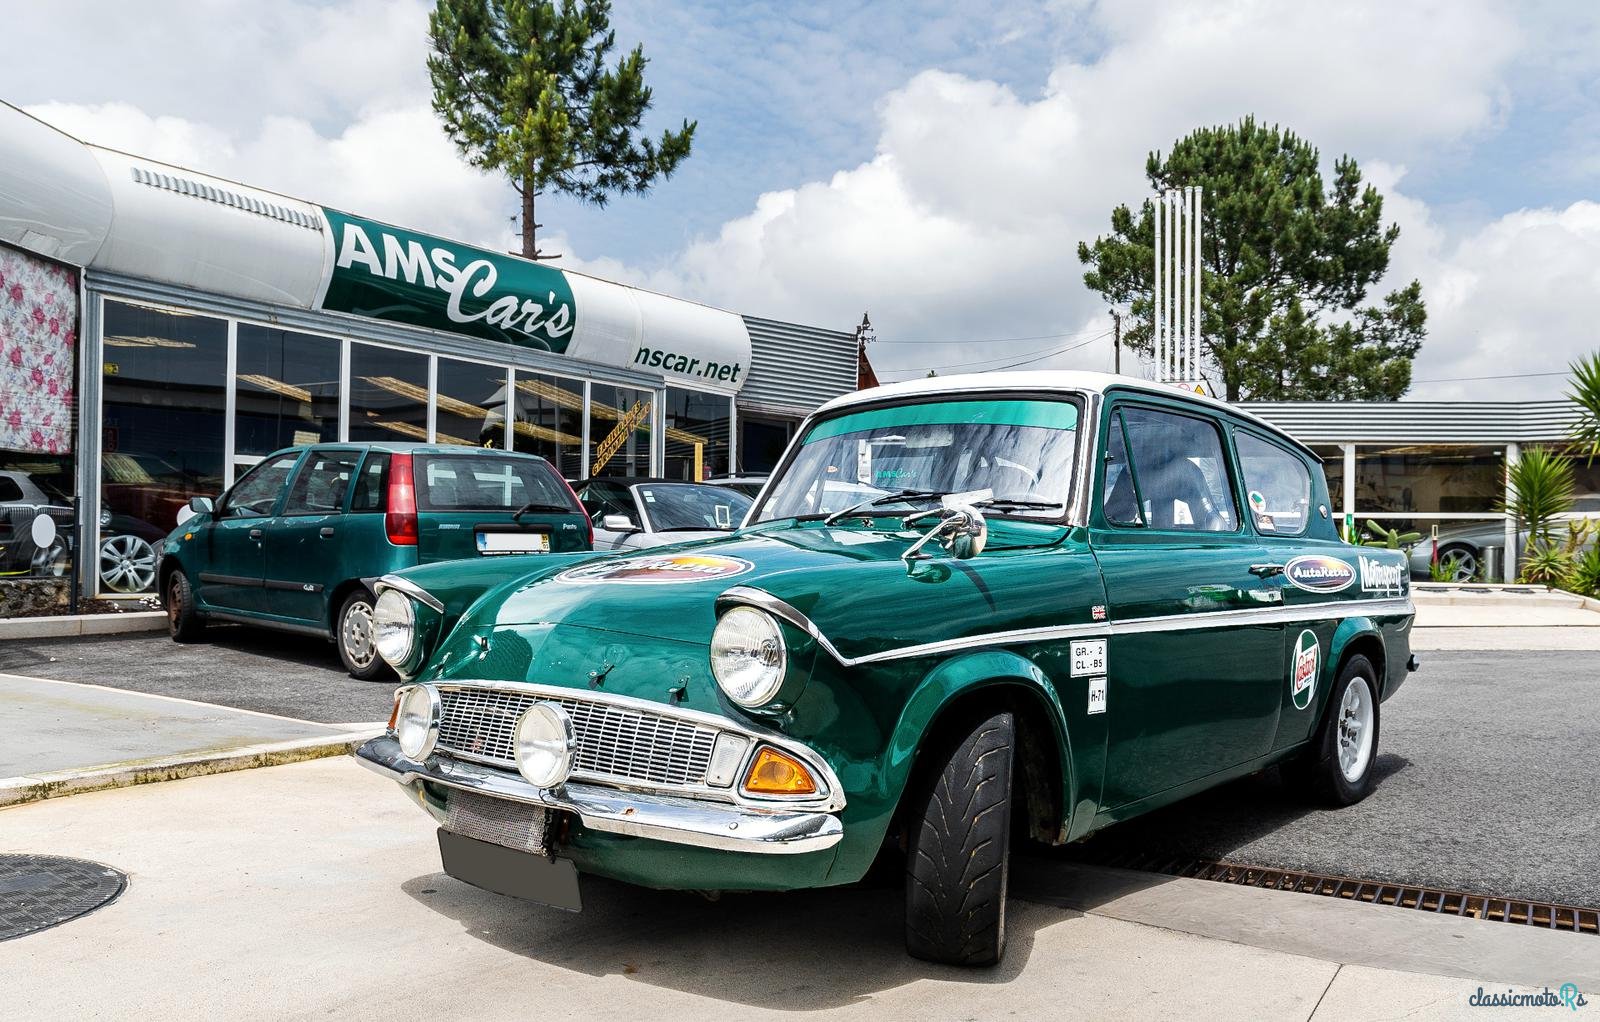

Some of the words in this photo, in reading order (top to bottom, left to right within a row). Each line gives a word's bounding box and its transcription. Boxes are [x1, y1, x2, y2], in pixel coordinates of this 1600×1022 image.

[336, 222, 462, 293] AMS
[446, 259, 573, 338] Car's
[1098, 646, 1103, 655] 2
